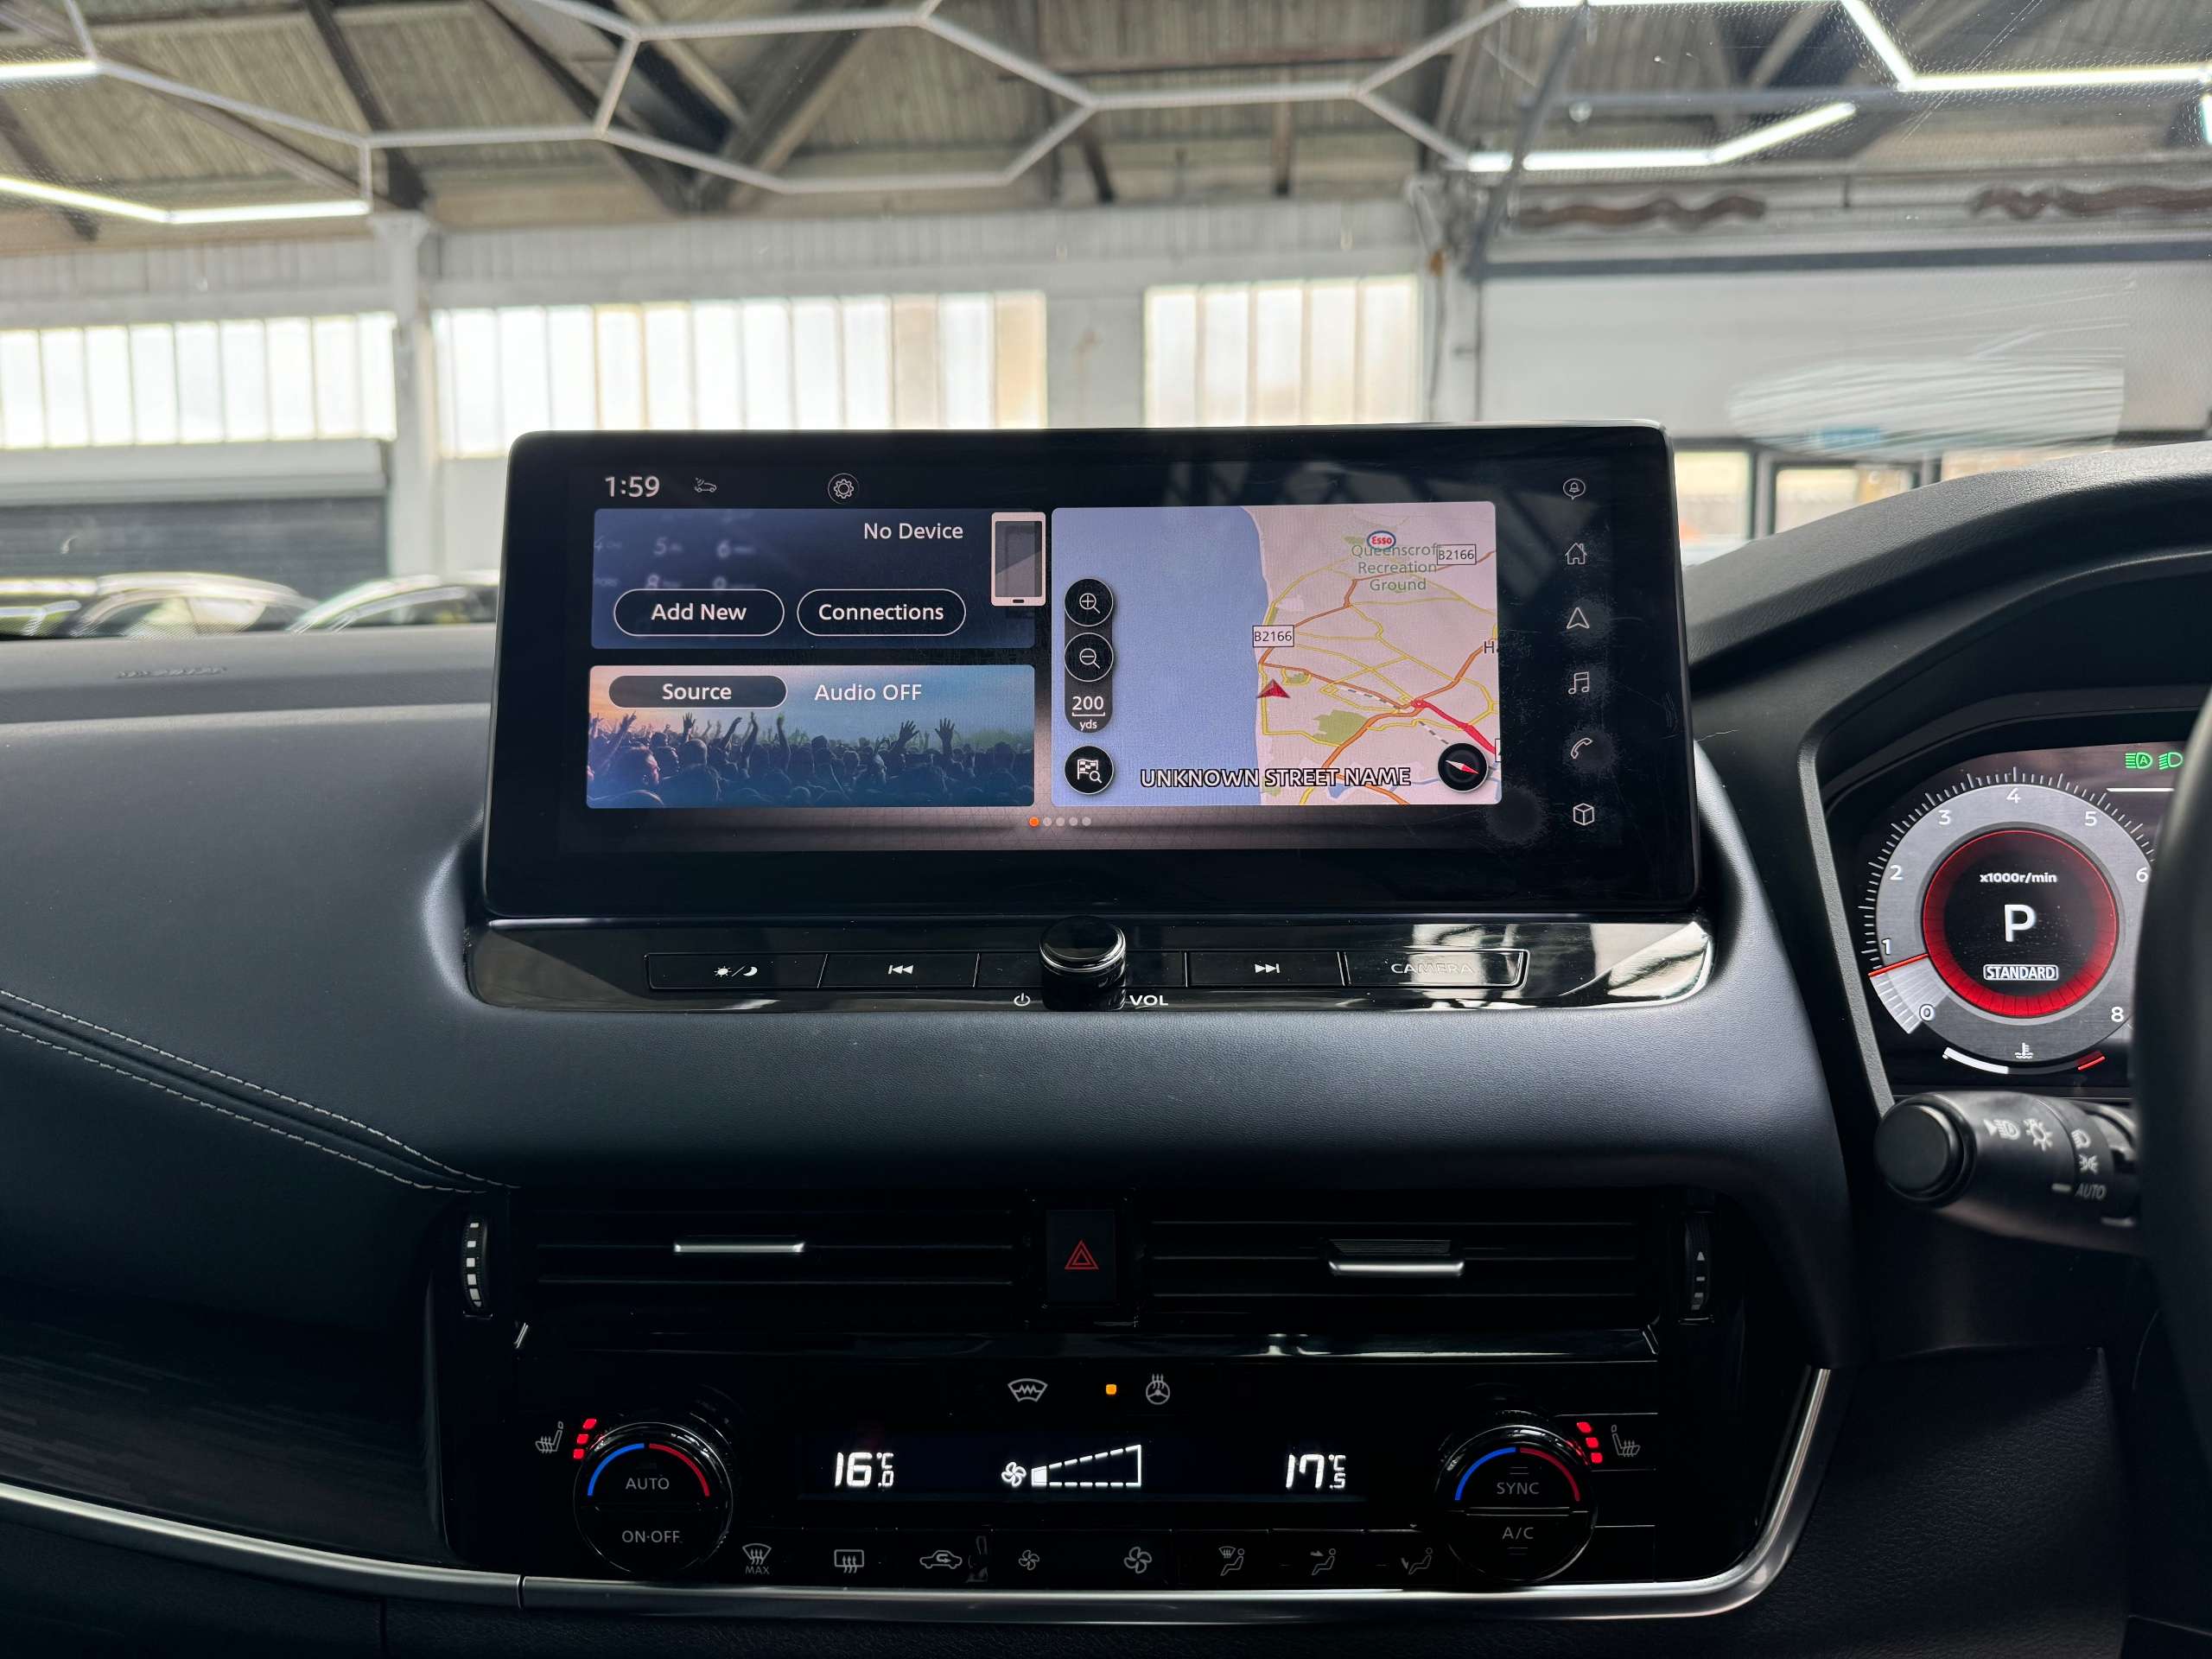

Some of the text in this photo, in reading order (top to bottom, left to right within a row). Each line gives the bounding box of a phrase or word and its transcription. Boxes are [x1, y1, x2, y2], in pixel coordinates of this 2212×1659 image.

[605, 475, 660, 499] 1:59
[863, 523, 963, 540] No Device
[1371, 536, 1393, 545] Esso
[1438, 549, 1475, 561] B2166
[1357, 562, 1437, 574] Recreation
[1370, 578, 1427, 591] Ground
[651, 602, 747, 620] Add New
[818, 603, 944, 621] Connections
[1254, 630, 1292, 643] B2166
[662, 683, 732, 701] Source
[814, 683, 922, 701] Audio OFF
[1072, 696, 1104, 711] 200
[1079, 719, 1098, 731] yds
[1141, 767, 1411, 788] UNKNOWN STREET NAME
[2006, 787, 2021, 804] 4
[1938, 810, 1951, 825] 3
[2084, 811, 2097, 827] 5
[1890, 865, 1904, 880] 2
[1980, 872, 2057, 885] x1000r/min
[2136, 868, 2149, 883] 6
[2004, 904, 2037, 943] P
[1882, 938, 1892, 955] 1
[1390, 963, 1474, 975] CAMERA
[1986, 965, 2056, 981] STANDARD
[1129, 995, 1168, 1007] VOL
[1919, 1005, 1935, 1021] 0
[2111, 1006, 2124, 1023] 8
[2075, 1184, 2107, 1200] AUTO
[834, 1452, 873, 1488] 16
[1285, 1452, 1325, 1490] 17
[625, 1476, 670, 1491] AUTO
[1496, 1482, 1540, 1496] SYNC
[1503, 1527, 1535, 1541] A/C
[745, 1565, 771, 1575] MAX
